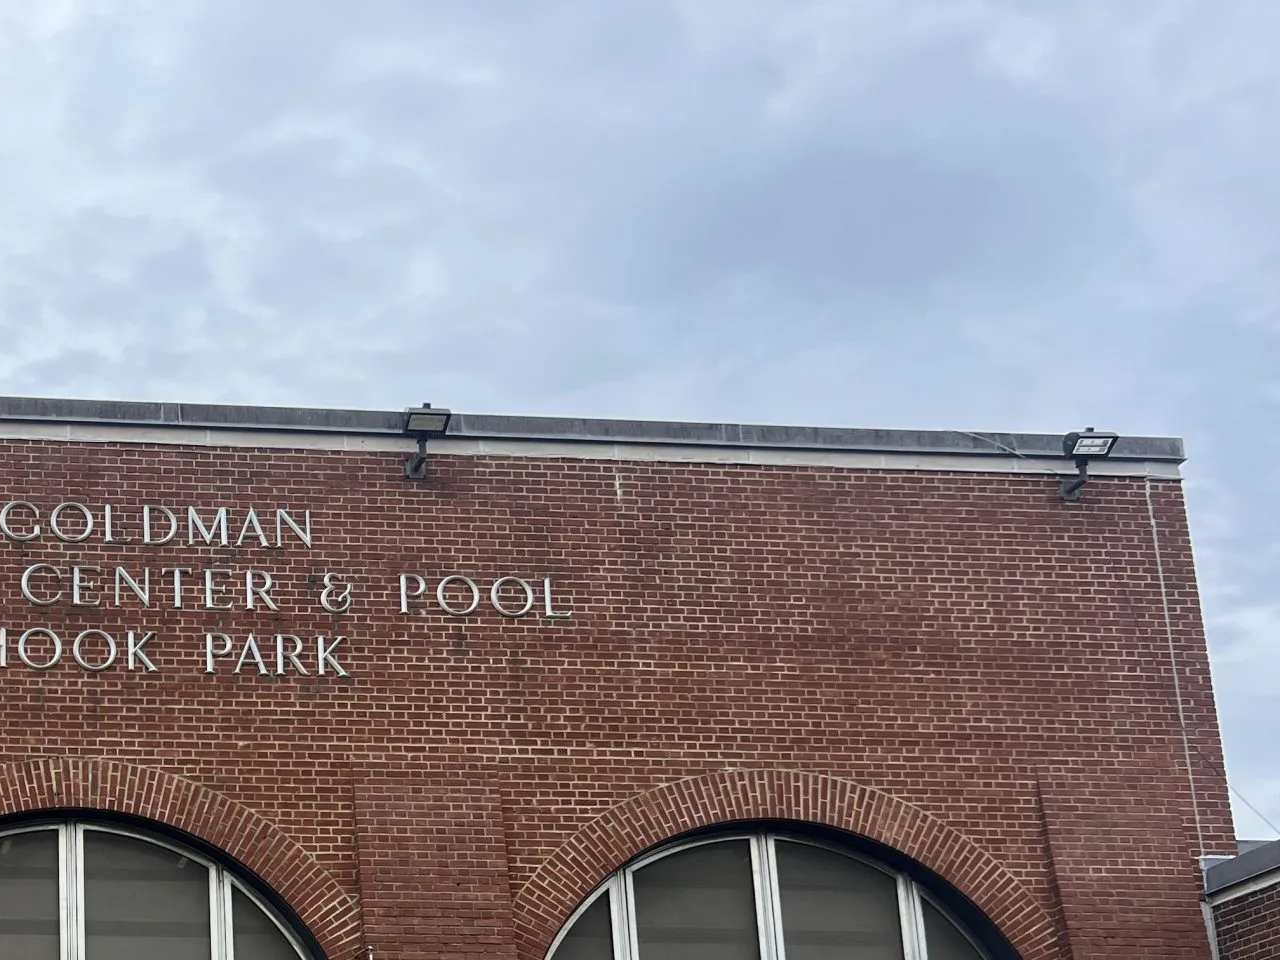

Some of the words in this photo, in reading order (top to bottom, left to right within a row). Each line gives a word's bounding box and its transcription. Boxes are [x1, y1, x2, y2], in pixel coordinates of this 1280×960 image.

[0, 500, 313, 549] GOLDMAN
[21, 563, 281, 612] CENTER
[320, 573, 352, 614] &
[398, 573, 573, 619] POOL
[204, 632, 352, 678] PARK
